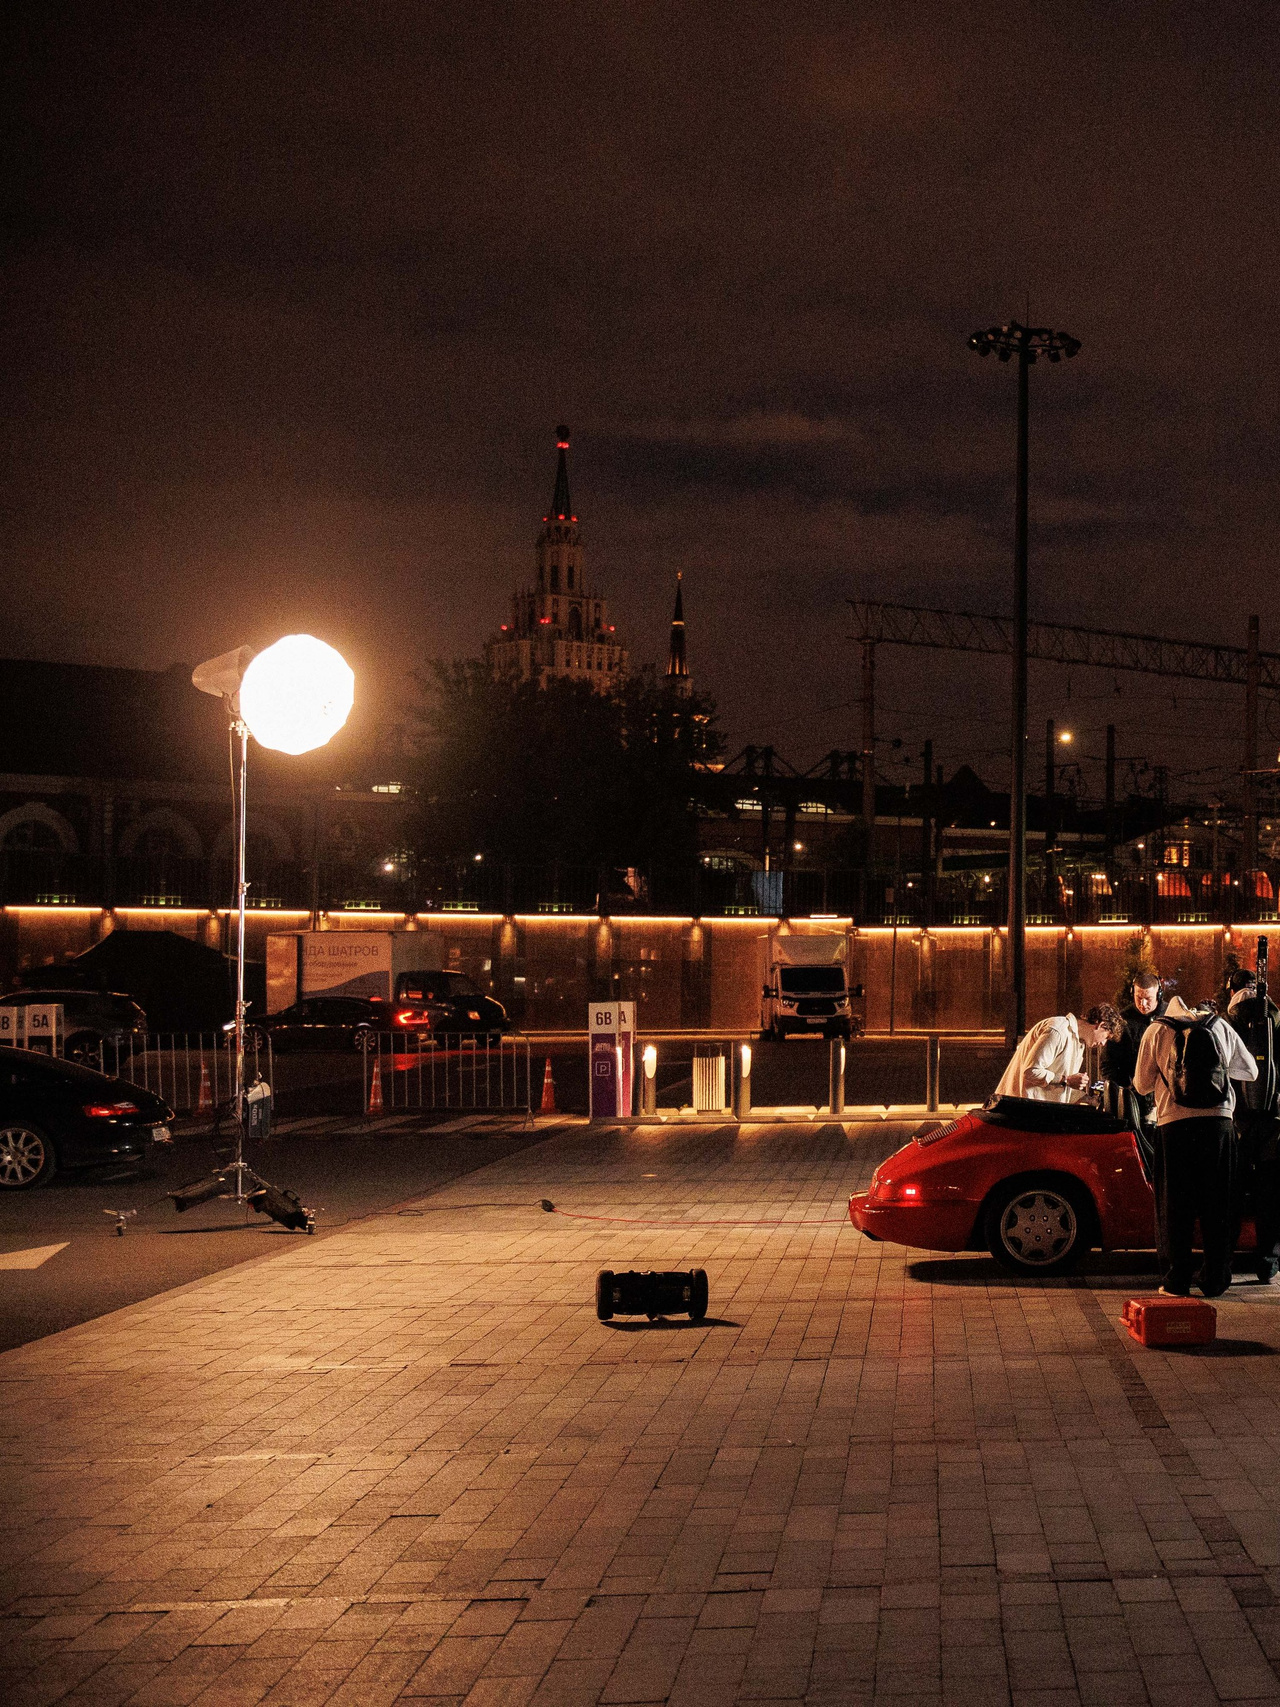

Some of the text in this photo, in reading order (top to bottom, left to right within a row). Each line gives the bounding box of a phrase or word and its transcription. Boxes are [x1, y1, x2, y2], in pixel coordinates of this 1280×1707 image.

[328, 945, 379, 956] ШАТРОВ
[1, 1015, 10, 1030] B
[33, 1014, 49, 1028] 5A
[595, 1011, 612, 1026] 6B
